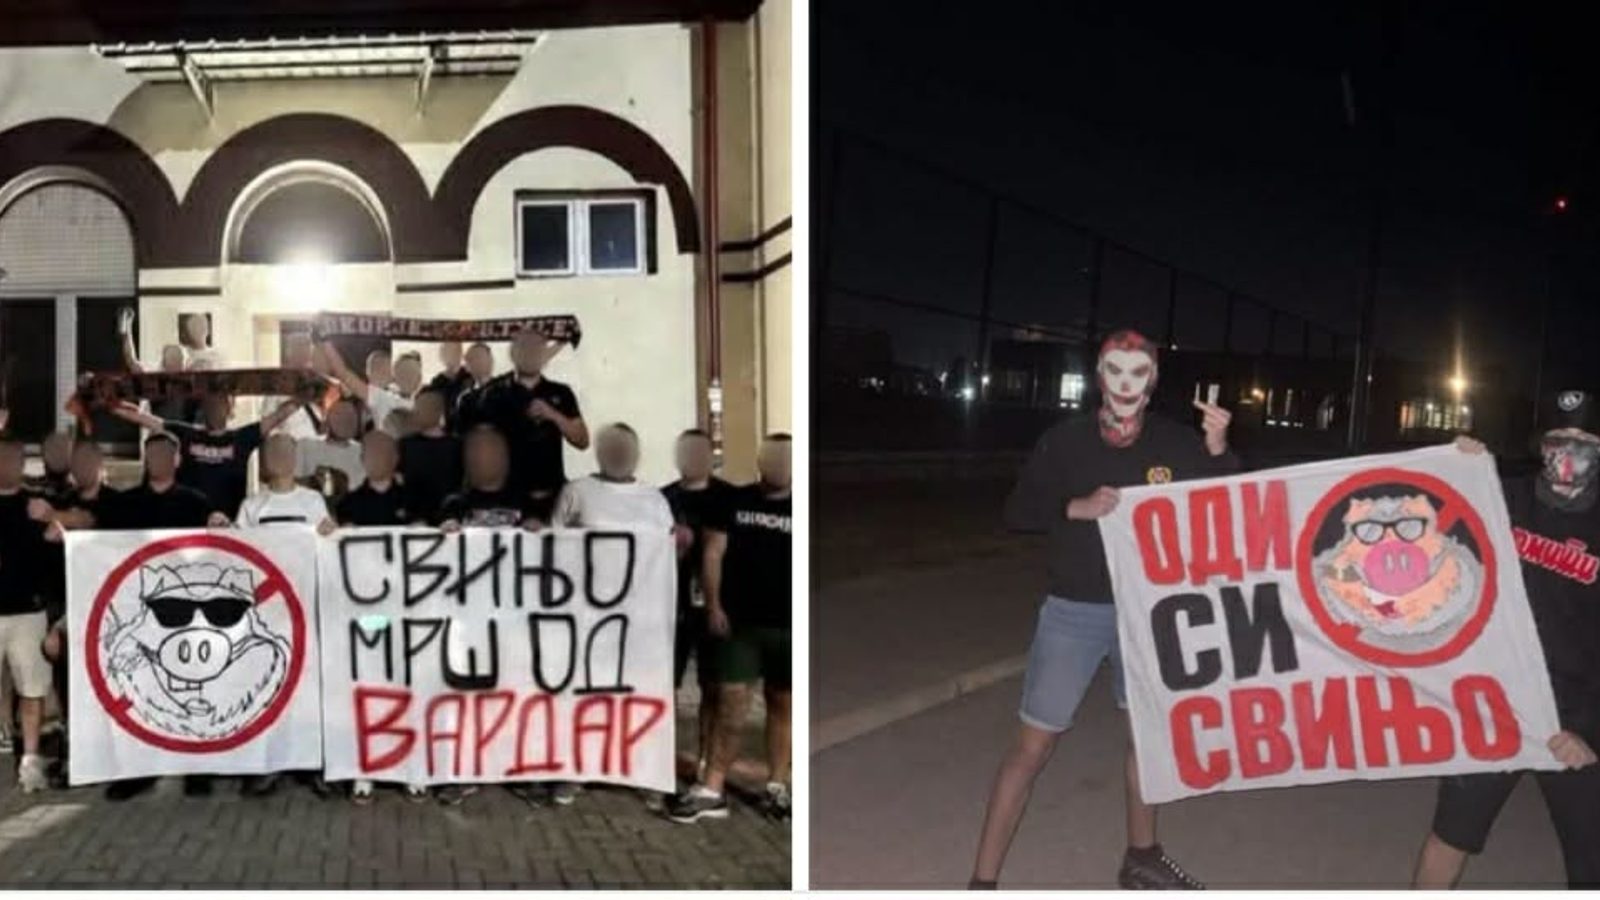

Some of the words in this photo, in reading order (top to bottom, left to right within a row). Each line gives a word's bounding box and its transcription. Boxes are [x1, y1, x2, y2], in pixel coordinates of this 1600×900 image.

[338, 531, 635, 609] СВИЊО
[1132, 480, 1293, 586] ОДИ
[349, 616, 499, 690] МРШ
[527, 612, 635, 695] ОД
[1150, 582, 1299, 692] СИ
[353, 686, 667, 777] ВАРДАР
[1168, 674, 1522, 790] СВИЊО
